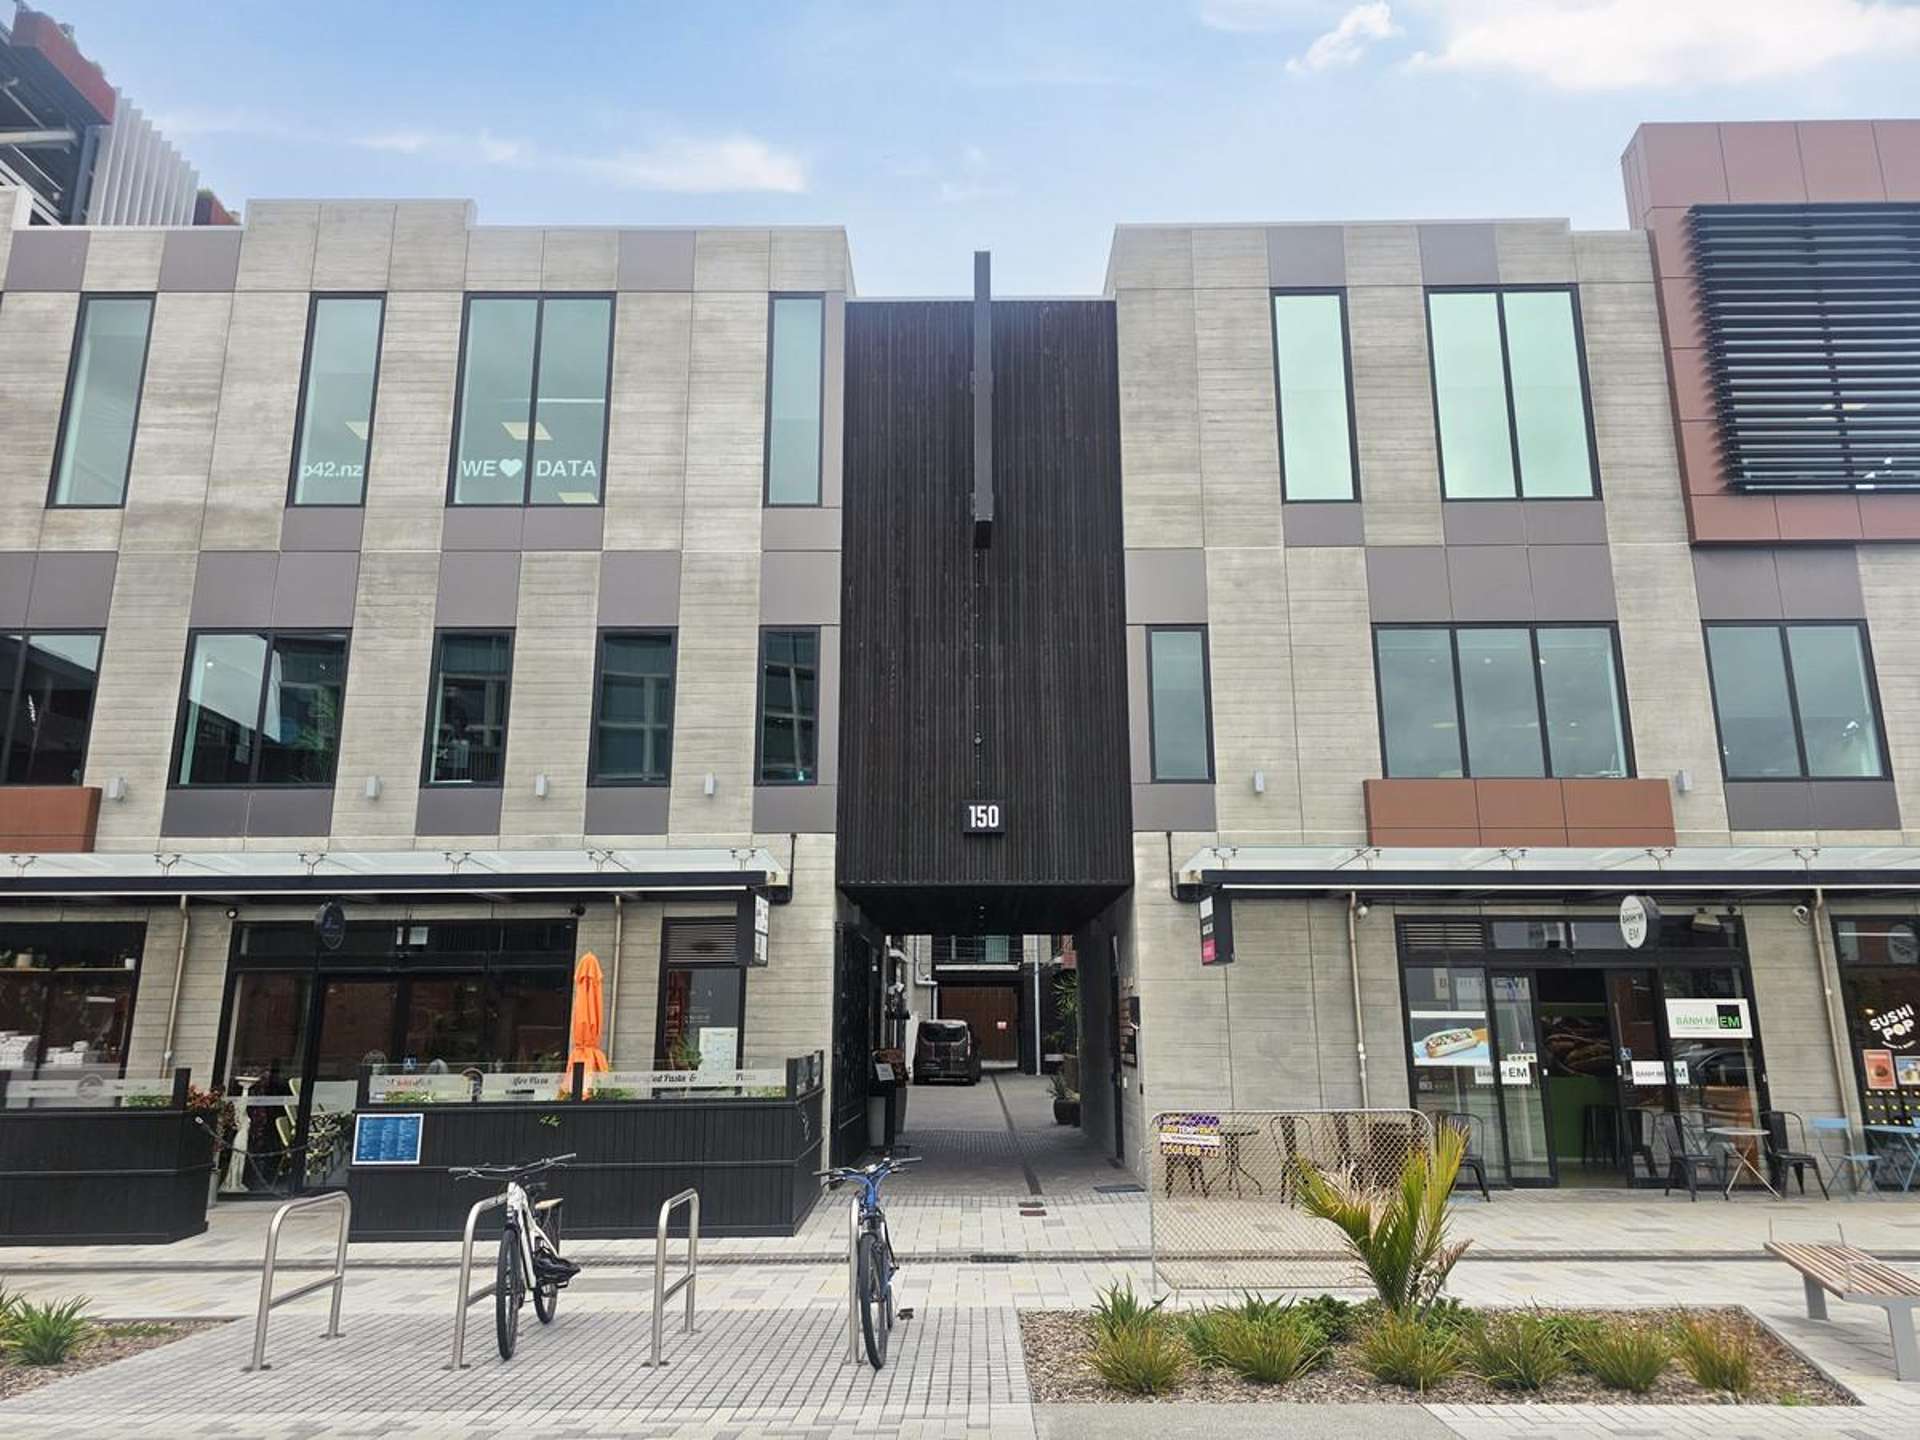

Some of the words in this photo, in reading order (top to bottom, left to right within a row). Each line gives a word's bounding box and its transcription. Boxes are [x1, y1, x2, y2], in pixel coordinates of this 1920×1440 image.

[462, 460, 497, 477] WE
[536, 460, 596, 477] DATA
[969, 805, 999, 828] 150
[1719, 1016, 1741, 1028] EM
[1869, 1003, 1915, 1031] SUSHI
[1882, 1018, 1915, 1041] POP
[1508, 1067, 1527, 1078] EM
